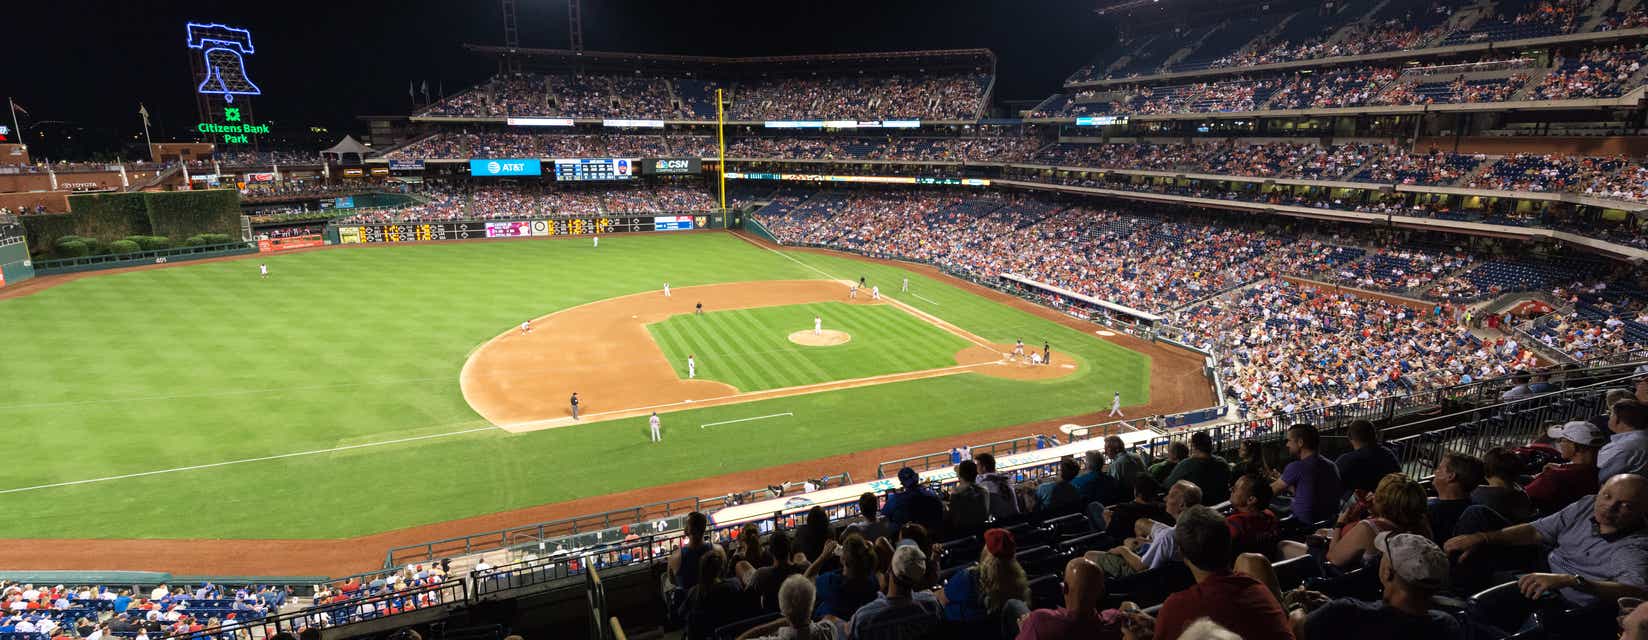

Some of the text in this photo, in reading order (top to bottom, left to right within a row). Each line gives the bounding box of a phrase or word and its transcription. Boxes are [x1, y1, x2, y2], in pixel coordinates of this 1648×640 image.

[197, 123, 270, 133] Citizens Bank
[224, 134, 249, 144] Park
[502, 163, 525, 172] AT&T
[668, 160, 689, 168] CSN
